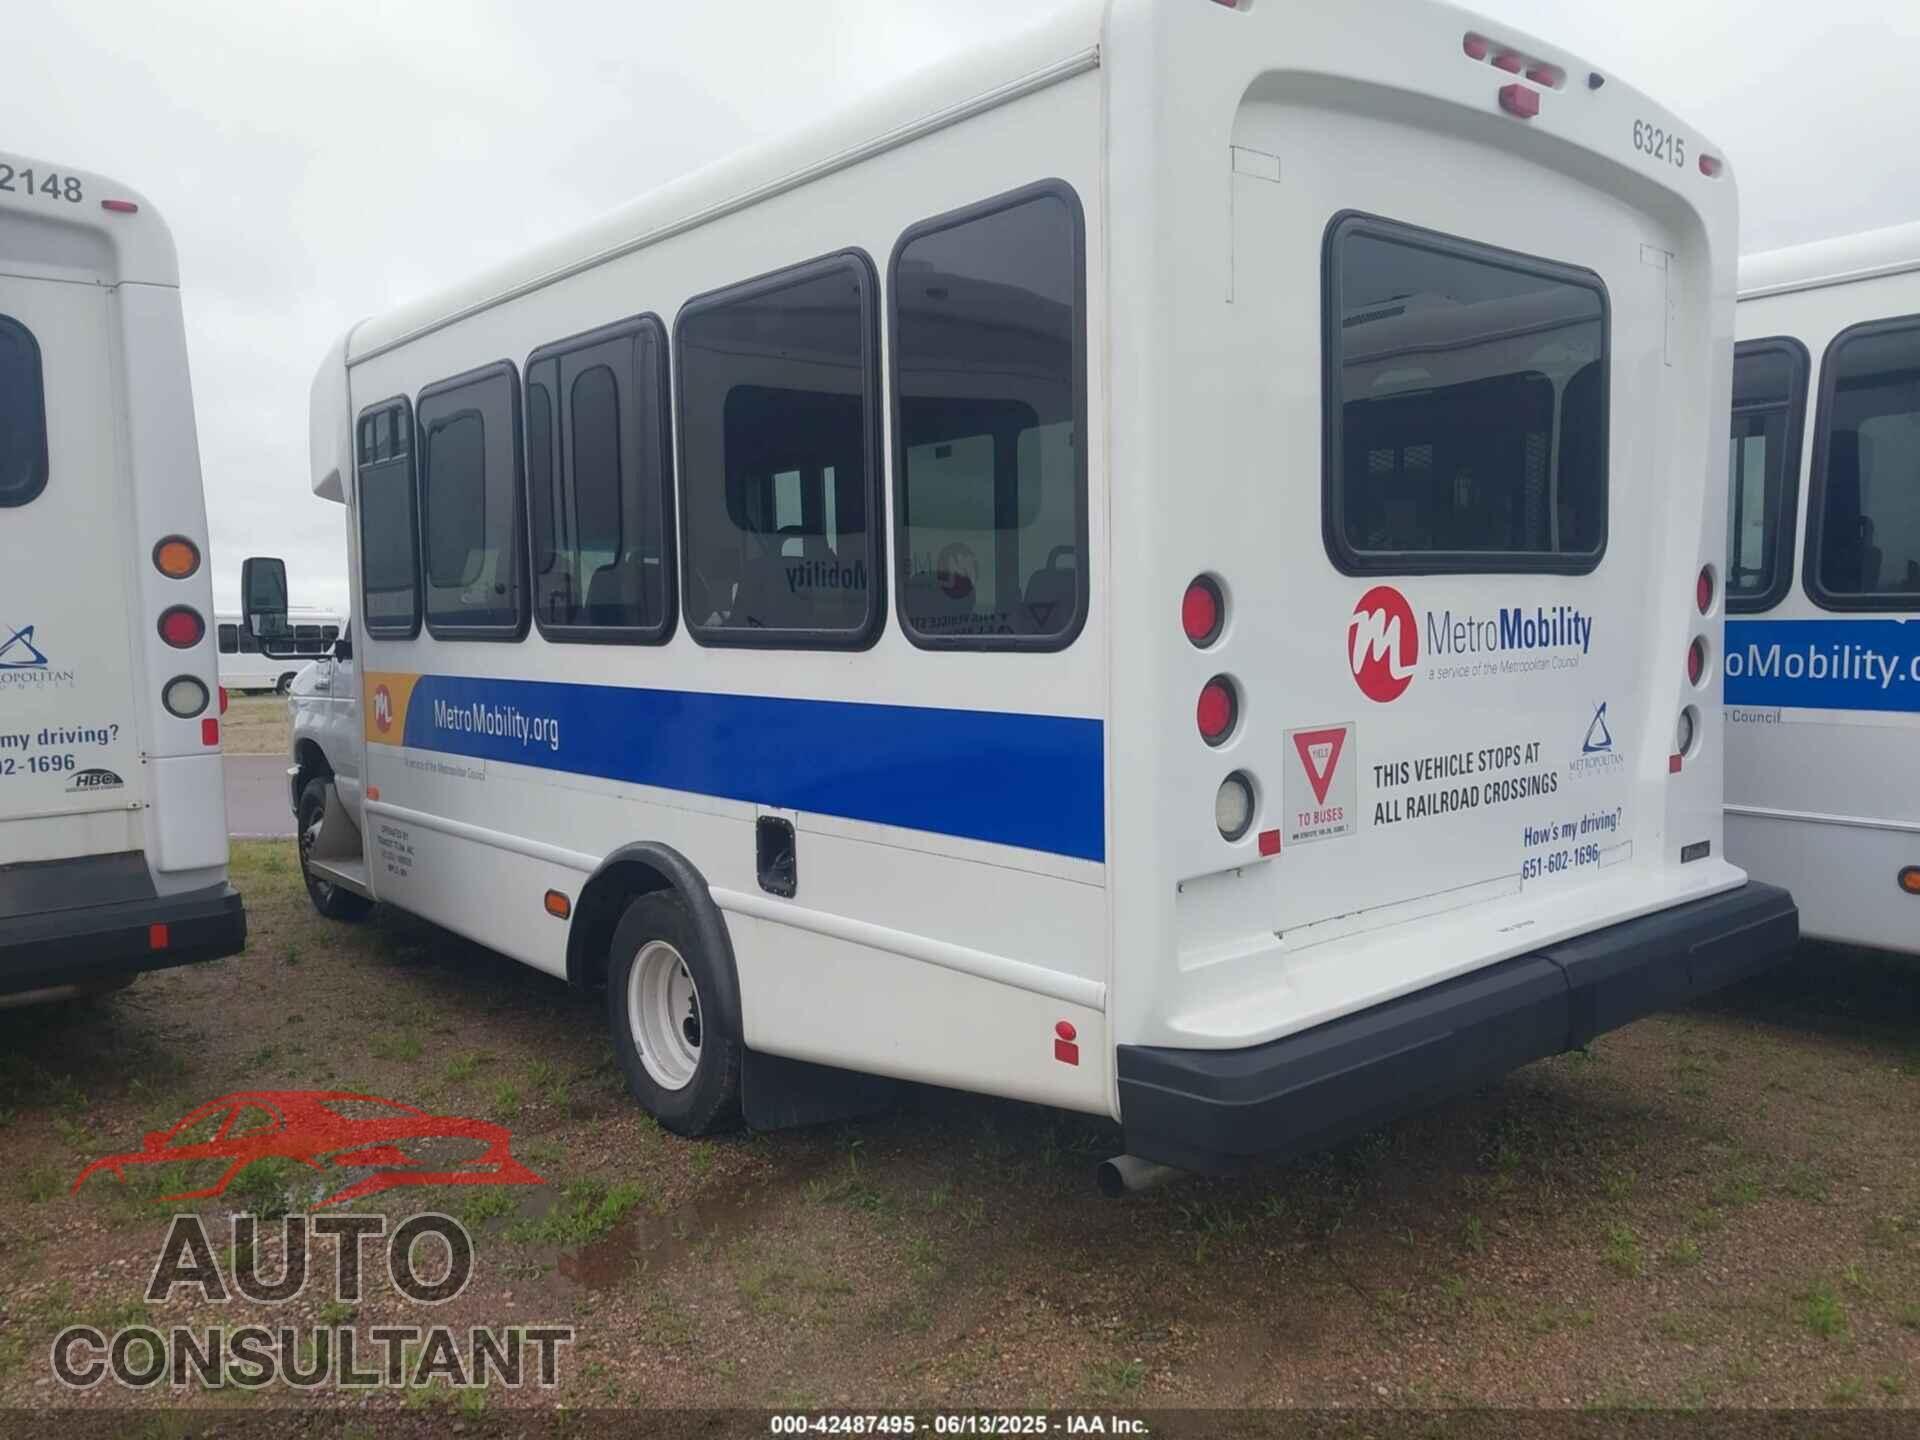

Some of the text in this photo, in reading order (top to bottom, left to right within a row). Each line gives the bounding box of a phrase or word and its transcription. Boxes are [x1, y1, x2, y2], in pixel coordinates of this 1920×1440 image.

[1633, 119, 1685, 168] 63215
[1427, 606, 1592, 654] MetroMobility
[0, 671, 74, 683] OPOLITAN
[1437, 665, 1469, 680] service
[1472, 663, 1482, 676] of
[1483, 662, 1498, 675] the
[37, 724, 119, 746] driving?
[434, 699, 560, 751] MetroMobility.org
[1733, 709, 1781, 724] Council
[0, 754, 75, 775] 2-1696
[1374, 742, 1541, 788] THIS VEHICLE STOPS AT
[1298, 807, 1344, 827] TO BUSES
[1374, 802, 1401, 826] ALL
[1407, 785, 1479, 820] RAILROAD
[1484, 771, 1558, 805] CROSSINGS
[1524, 807, 1622, 848] How's my driving?
[1523, 843, 1598, 880] 651-602-1696
